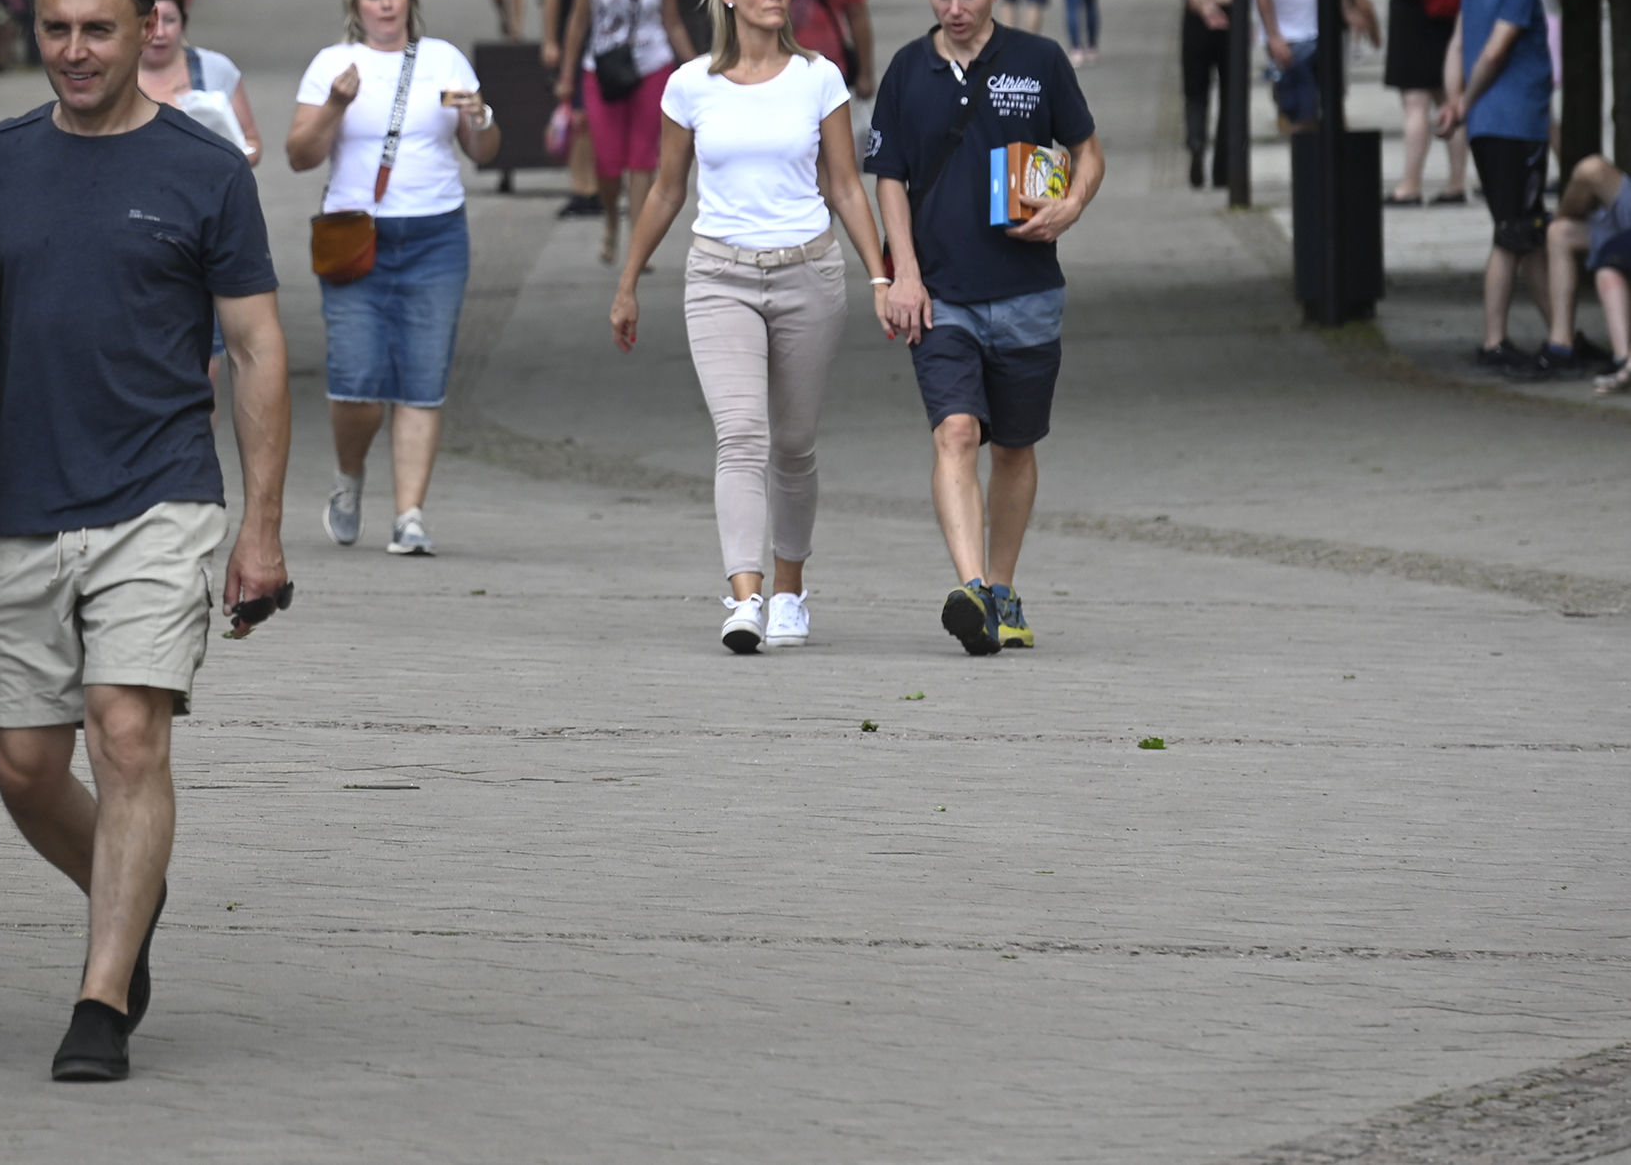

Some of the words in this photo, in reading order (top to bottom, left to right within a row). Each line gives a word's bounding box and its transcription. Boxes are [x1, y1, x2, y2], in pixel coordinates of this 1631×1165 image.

[986, 72, 1042, 94] Athletics
[989, 92, 1005, 100] NEW
[1008, 93, 1025, 101] YORK
[1027, 94, 1040, 104] CITY
[992, 99, 1036, 111] DEPARTMENT
